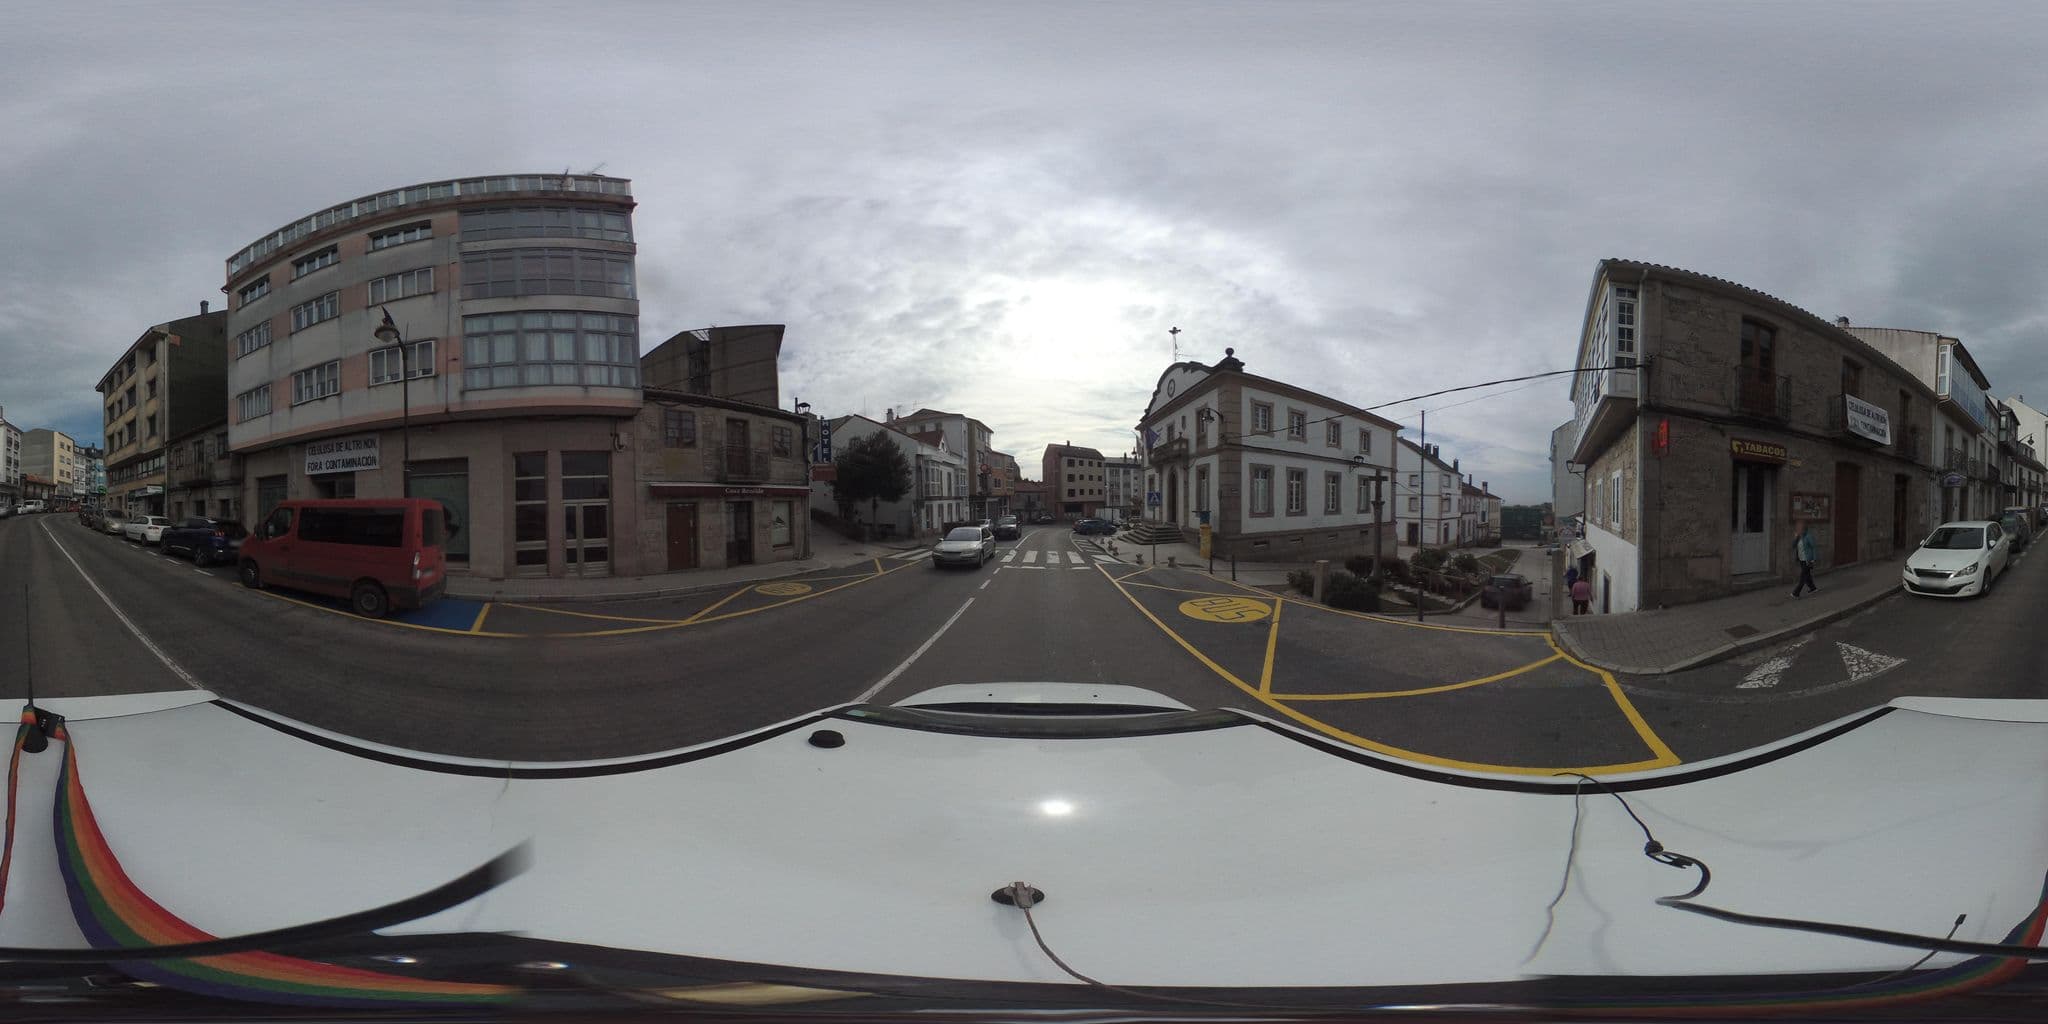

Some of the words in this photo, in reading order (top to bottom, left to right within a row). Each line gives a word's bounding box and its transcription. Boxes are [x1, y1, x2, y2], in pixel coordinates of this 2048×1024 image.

[308, 441, 335, 456] CELULOSA
[336, 441, 343, 452] DE
[343, 439, 362, 451] ALTRI
[363, 438, 377, 450] NON
[822, 421, 830, 463] HOTEL
[1744, 441, 1786, 457] TABACOS
[307, 461, 323, 473] FORA
[325, 454, 377, 470] CONTAMINACIÓN
[1189, 597, 1266, 621] BUS
